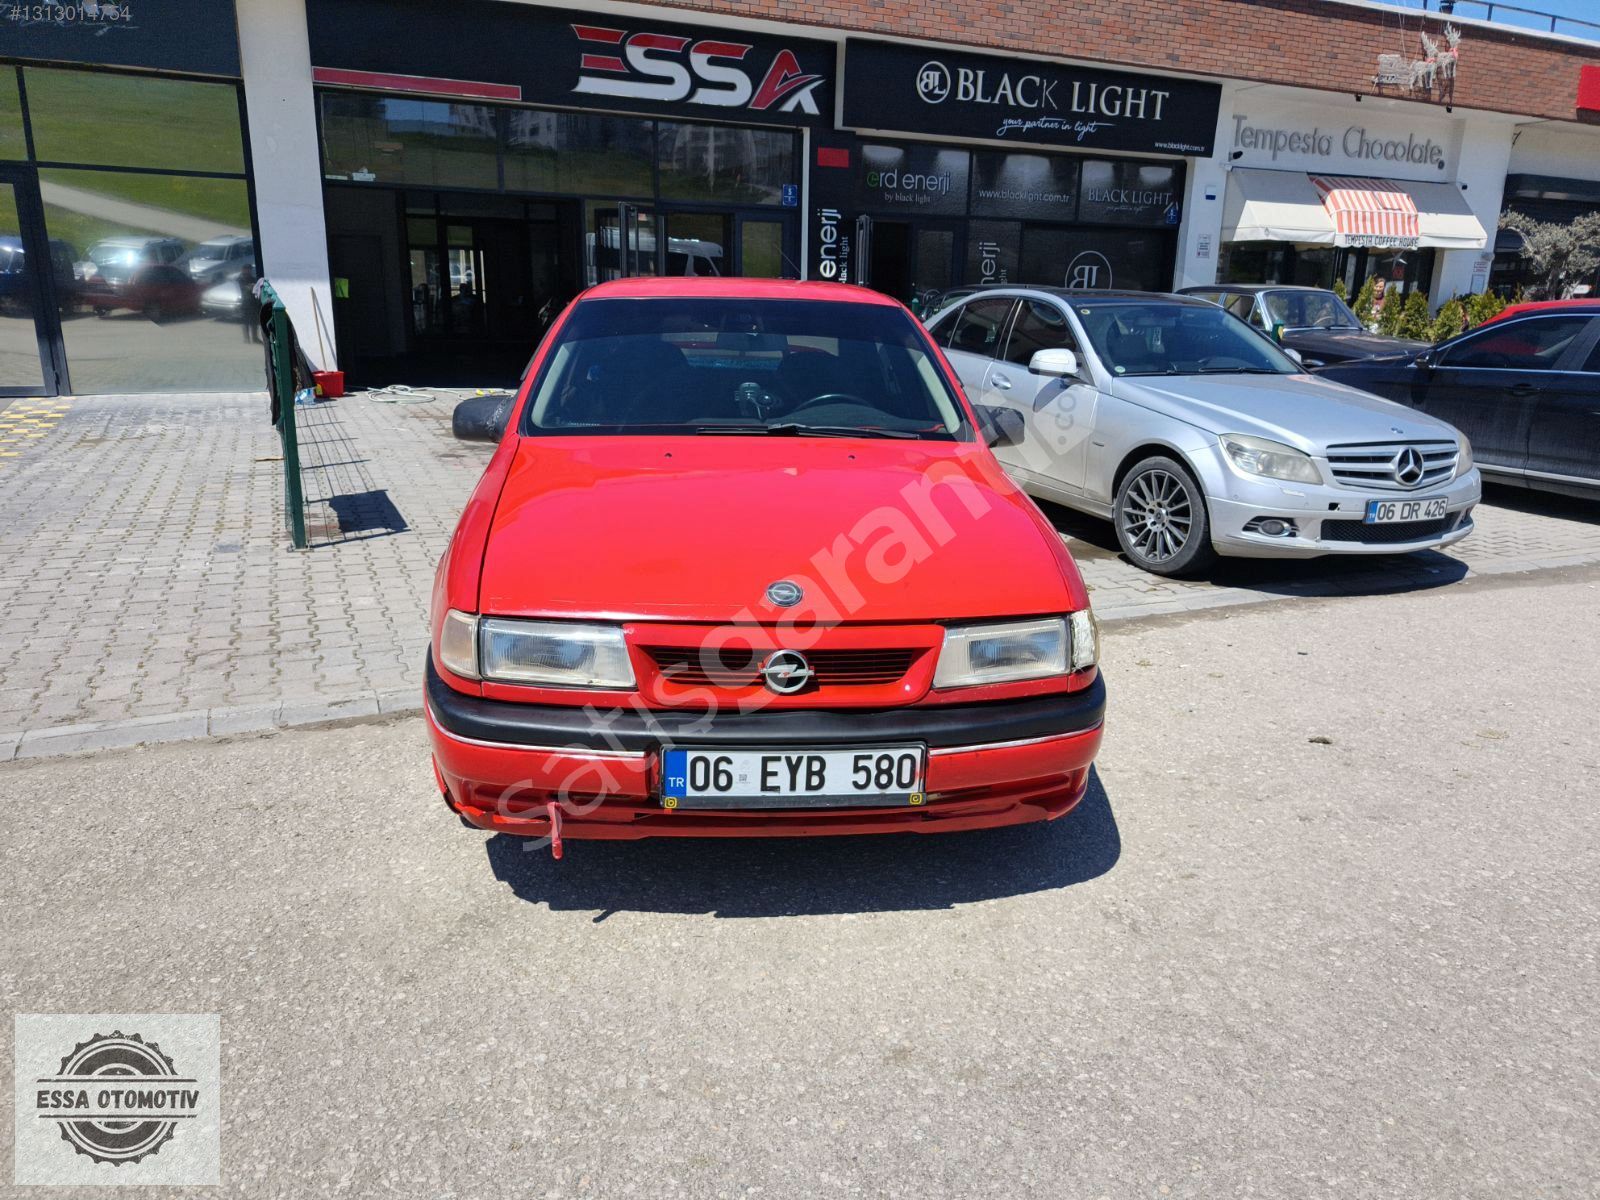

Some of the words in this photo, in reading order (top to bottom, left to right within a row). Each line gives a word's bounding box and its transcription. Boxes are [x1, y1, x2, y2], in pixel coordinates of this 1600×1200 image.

[570, 23, 827, 116] ESSA
[956, 67, 1058, 110] BLACK
[1071, 80, 1170, 121] LIGHT
[1022, 116, 1066, 133] partner
[1061, 119, 1073, 131] in
[1074, 121, 1117, 142] light
[1232, 114, 1333, 161] Tempesta
[902, 170, 951, 196] enerji
[884, 191, 894, 202] by
[894, 192, 913, 202] black
[1087, 187, 1129, 204] BLACK
[1131, 191, 1172, 207] LIGHT
[816, 208, 842, 278] enerji
[1344, 234, 1373, 247] TEMPESTA
[1374, 235, 1398, 248] COFFEE
[838, 261, 848, 284] lack
[979, 241, 1001, 286] nerji
[1377, 503, 1396, 520] 06
[1400, 502, 1421, 521] DR
[1424, 500, 1446, 518] 426
[668, 776, 685, 788] TR
[689, 755, 734, 793] 06
[760, 755, 827, 794] EYB
[852, 753, 918, 791] 580
